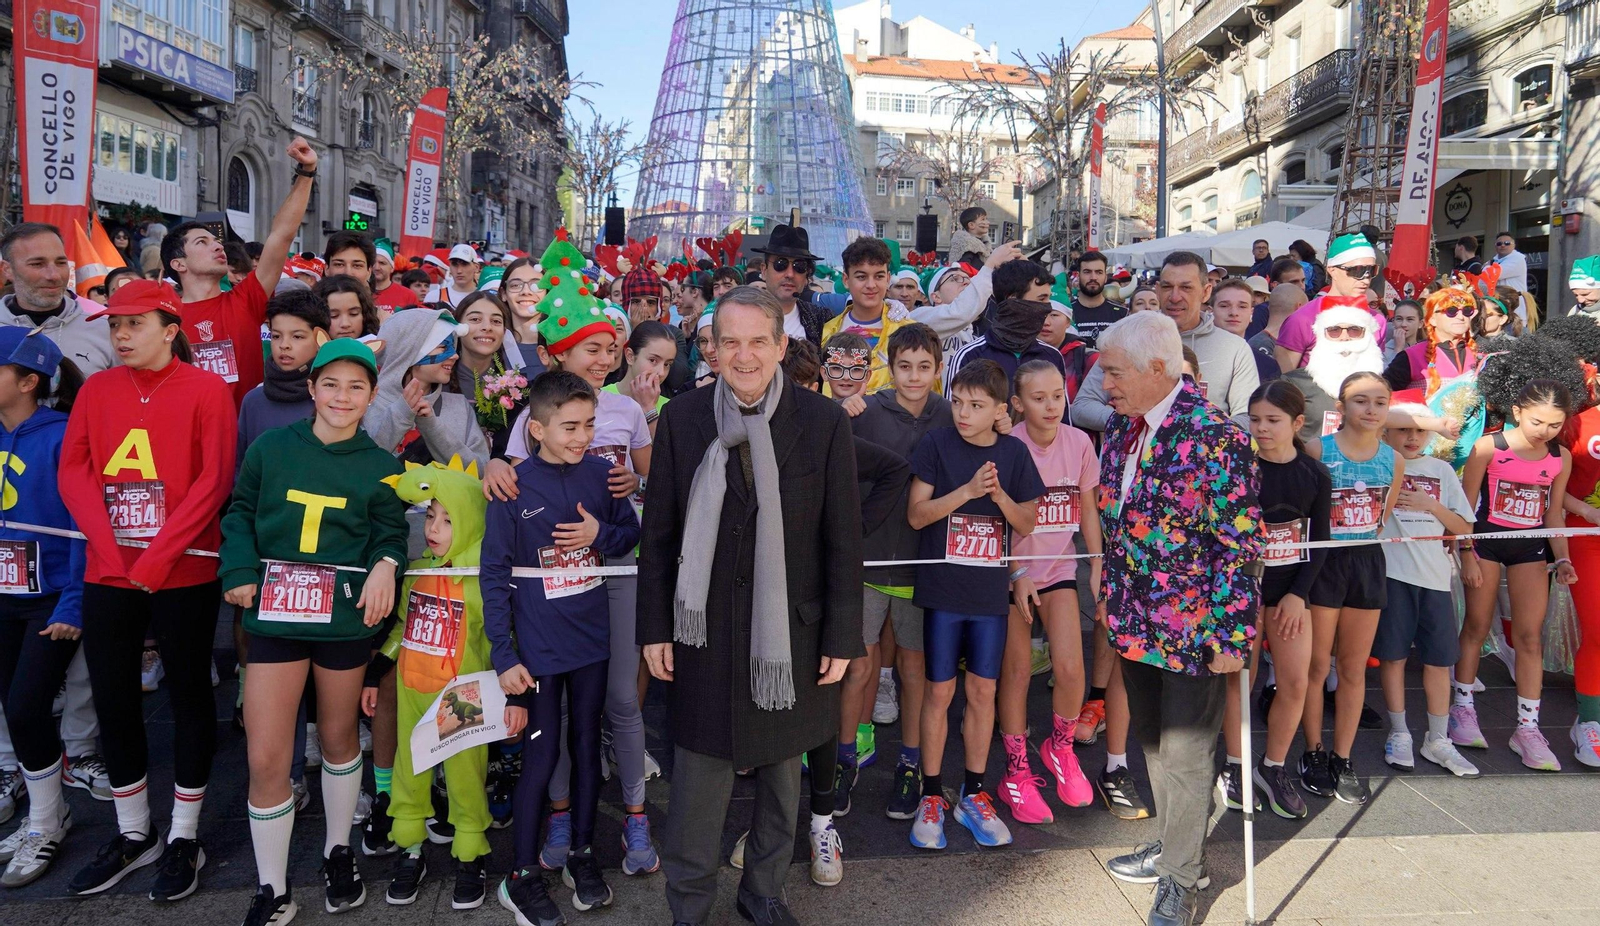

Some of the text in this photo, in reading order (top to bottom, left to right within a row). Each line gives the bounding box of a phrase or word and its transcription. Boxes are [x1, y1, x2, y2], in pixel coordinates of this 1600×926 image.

[118, 26, 191, 85] PSICA
[41, 73, 58, 195] CONCELLO
[59, 89, 76, 181] DE VIGO
[410, 167, 423, 231] CONCELLO
[421, 177, 432, 225] DE VIGO
[195, 349, 223, 360] vigo
[103, 428, 158, 480] A
[118, 492, 151, 504] vigo
[1043, 494, 1070, 504] vigo
[1345, 496, 1372, 506] vigo
[1513, 489, 1540, 500] vigo
[108, 503, 158, 527] 2354
[1037, 504, 1071, 524] 3011
[1343, 506, 1373, 525] 926
[1502, 497, 1541, 518] 2991
[286, 489, 348, 554] T
[966, 525, 995, 536] vigo
[955, 534, 998, 557] 2770
[1266, 530, 1292, 540] vigo
[0, 551, 15, 562] go
[561, 546, 590, 561] vigo
[0, 562, 18, 584] 09
[285, 573, 321, 586] vigo
[272, 586, 323, 611] 2108
[418, 605, 449, 620] vigo
[411, 618, 443, 645] 831
[430, 740, 450, 754] BUSCO
[449, 730, 471, 744] HOGAR
[480, 724, 497, 732] VIGO
